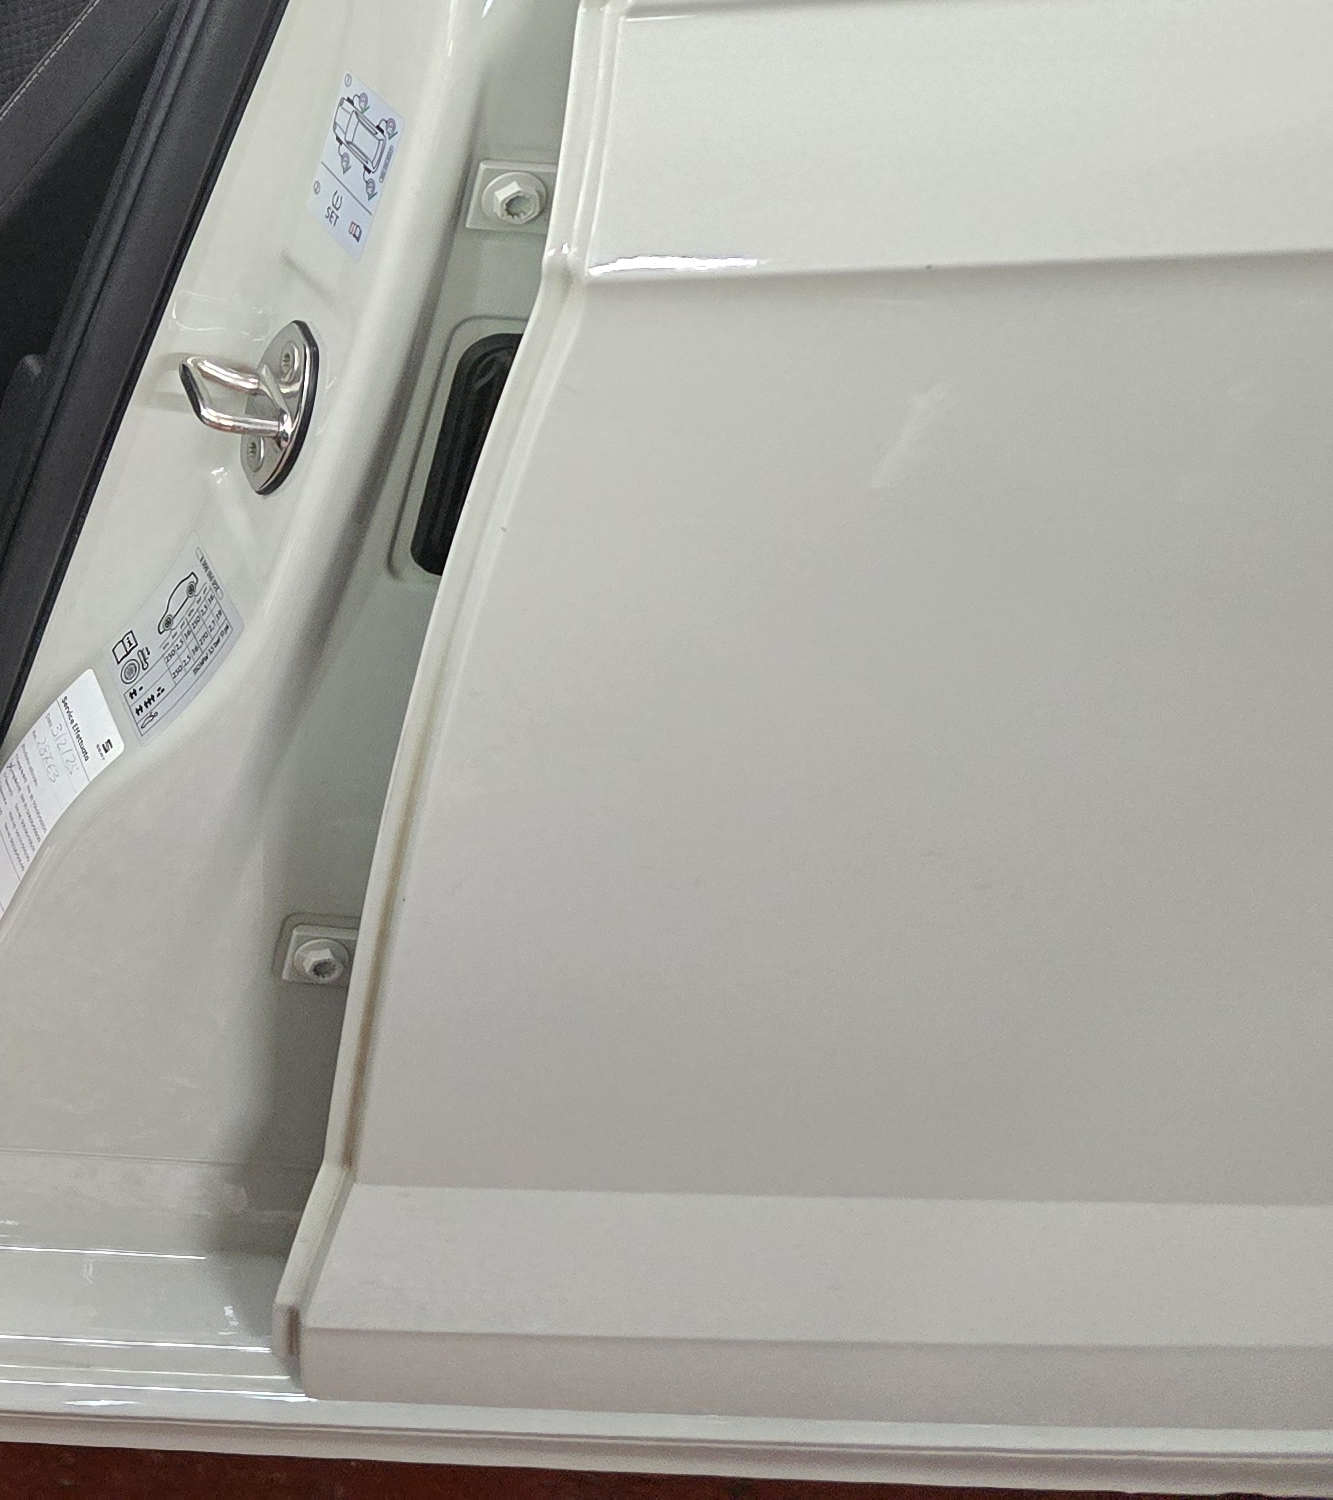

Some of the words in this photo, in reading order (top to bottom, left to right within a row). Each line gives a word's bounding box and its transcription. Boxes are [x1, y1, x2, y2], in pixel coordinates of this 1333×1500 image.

[325, 207, 339, 226] SET
[61, 695, 74, 724] Service
[72, 722, 90, 762] Effettuato
